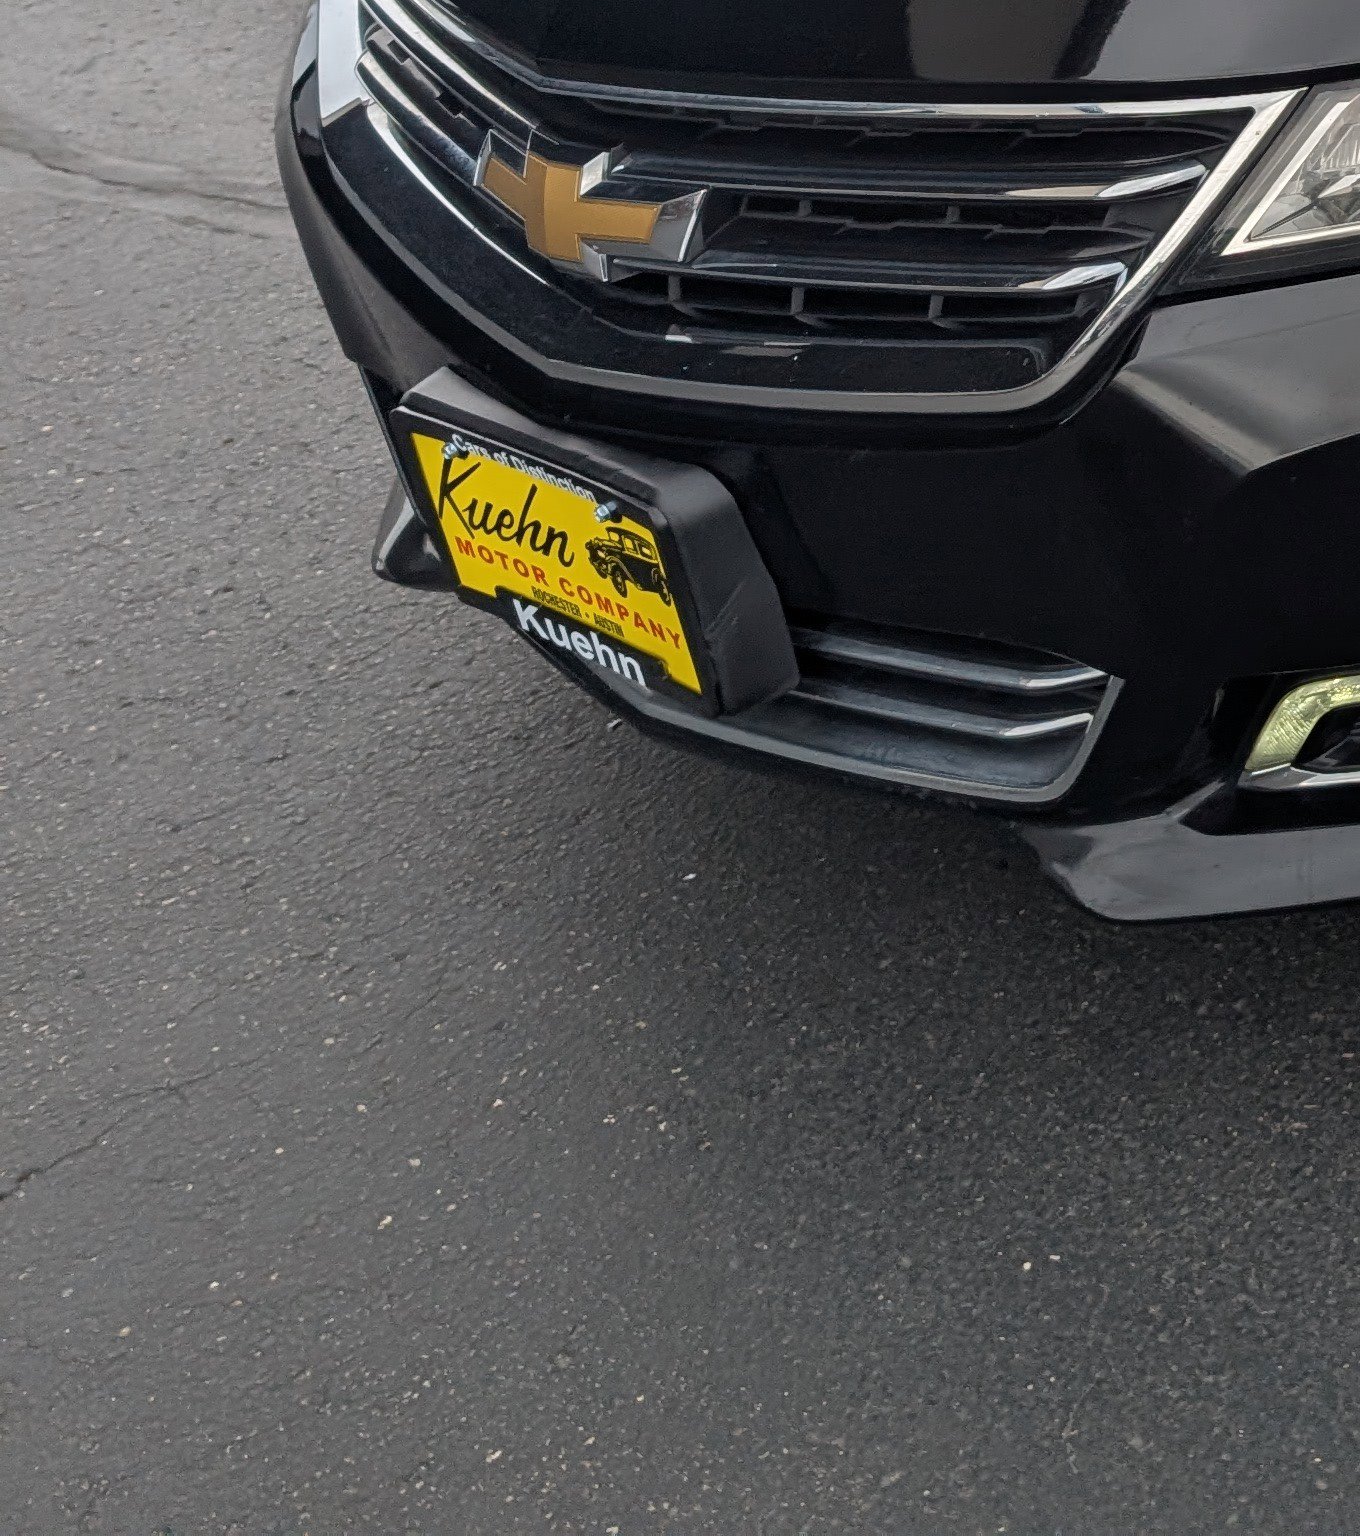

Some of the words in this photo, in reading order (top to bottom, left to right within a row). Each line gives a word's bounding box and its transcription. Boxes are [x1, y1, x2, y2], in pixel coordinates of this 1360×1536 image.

[438, 457, 575, 568] Kuehn
[451, 433, 492, 461] Cars
[493, 451, 511, 467] of
[509, 454, 598, 503] Distinction
[454, 535, 551, 587] MOTOR
[558, 576, 681, 650] COMPANY
[531, 585, 583, 619] ROCHESTER
[593, 612, 625, 638] AUSTIN
[512, 597, 648, 688] Kuehn
